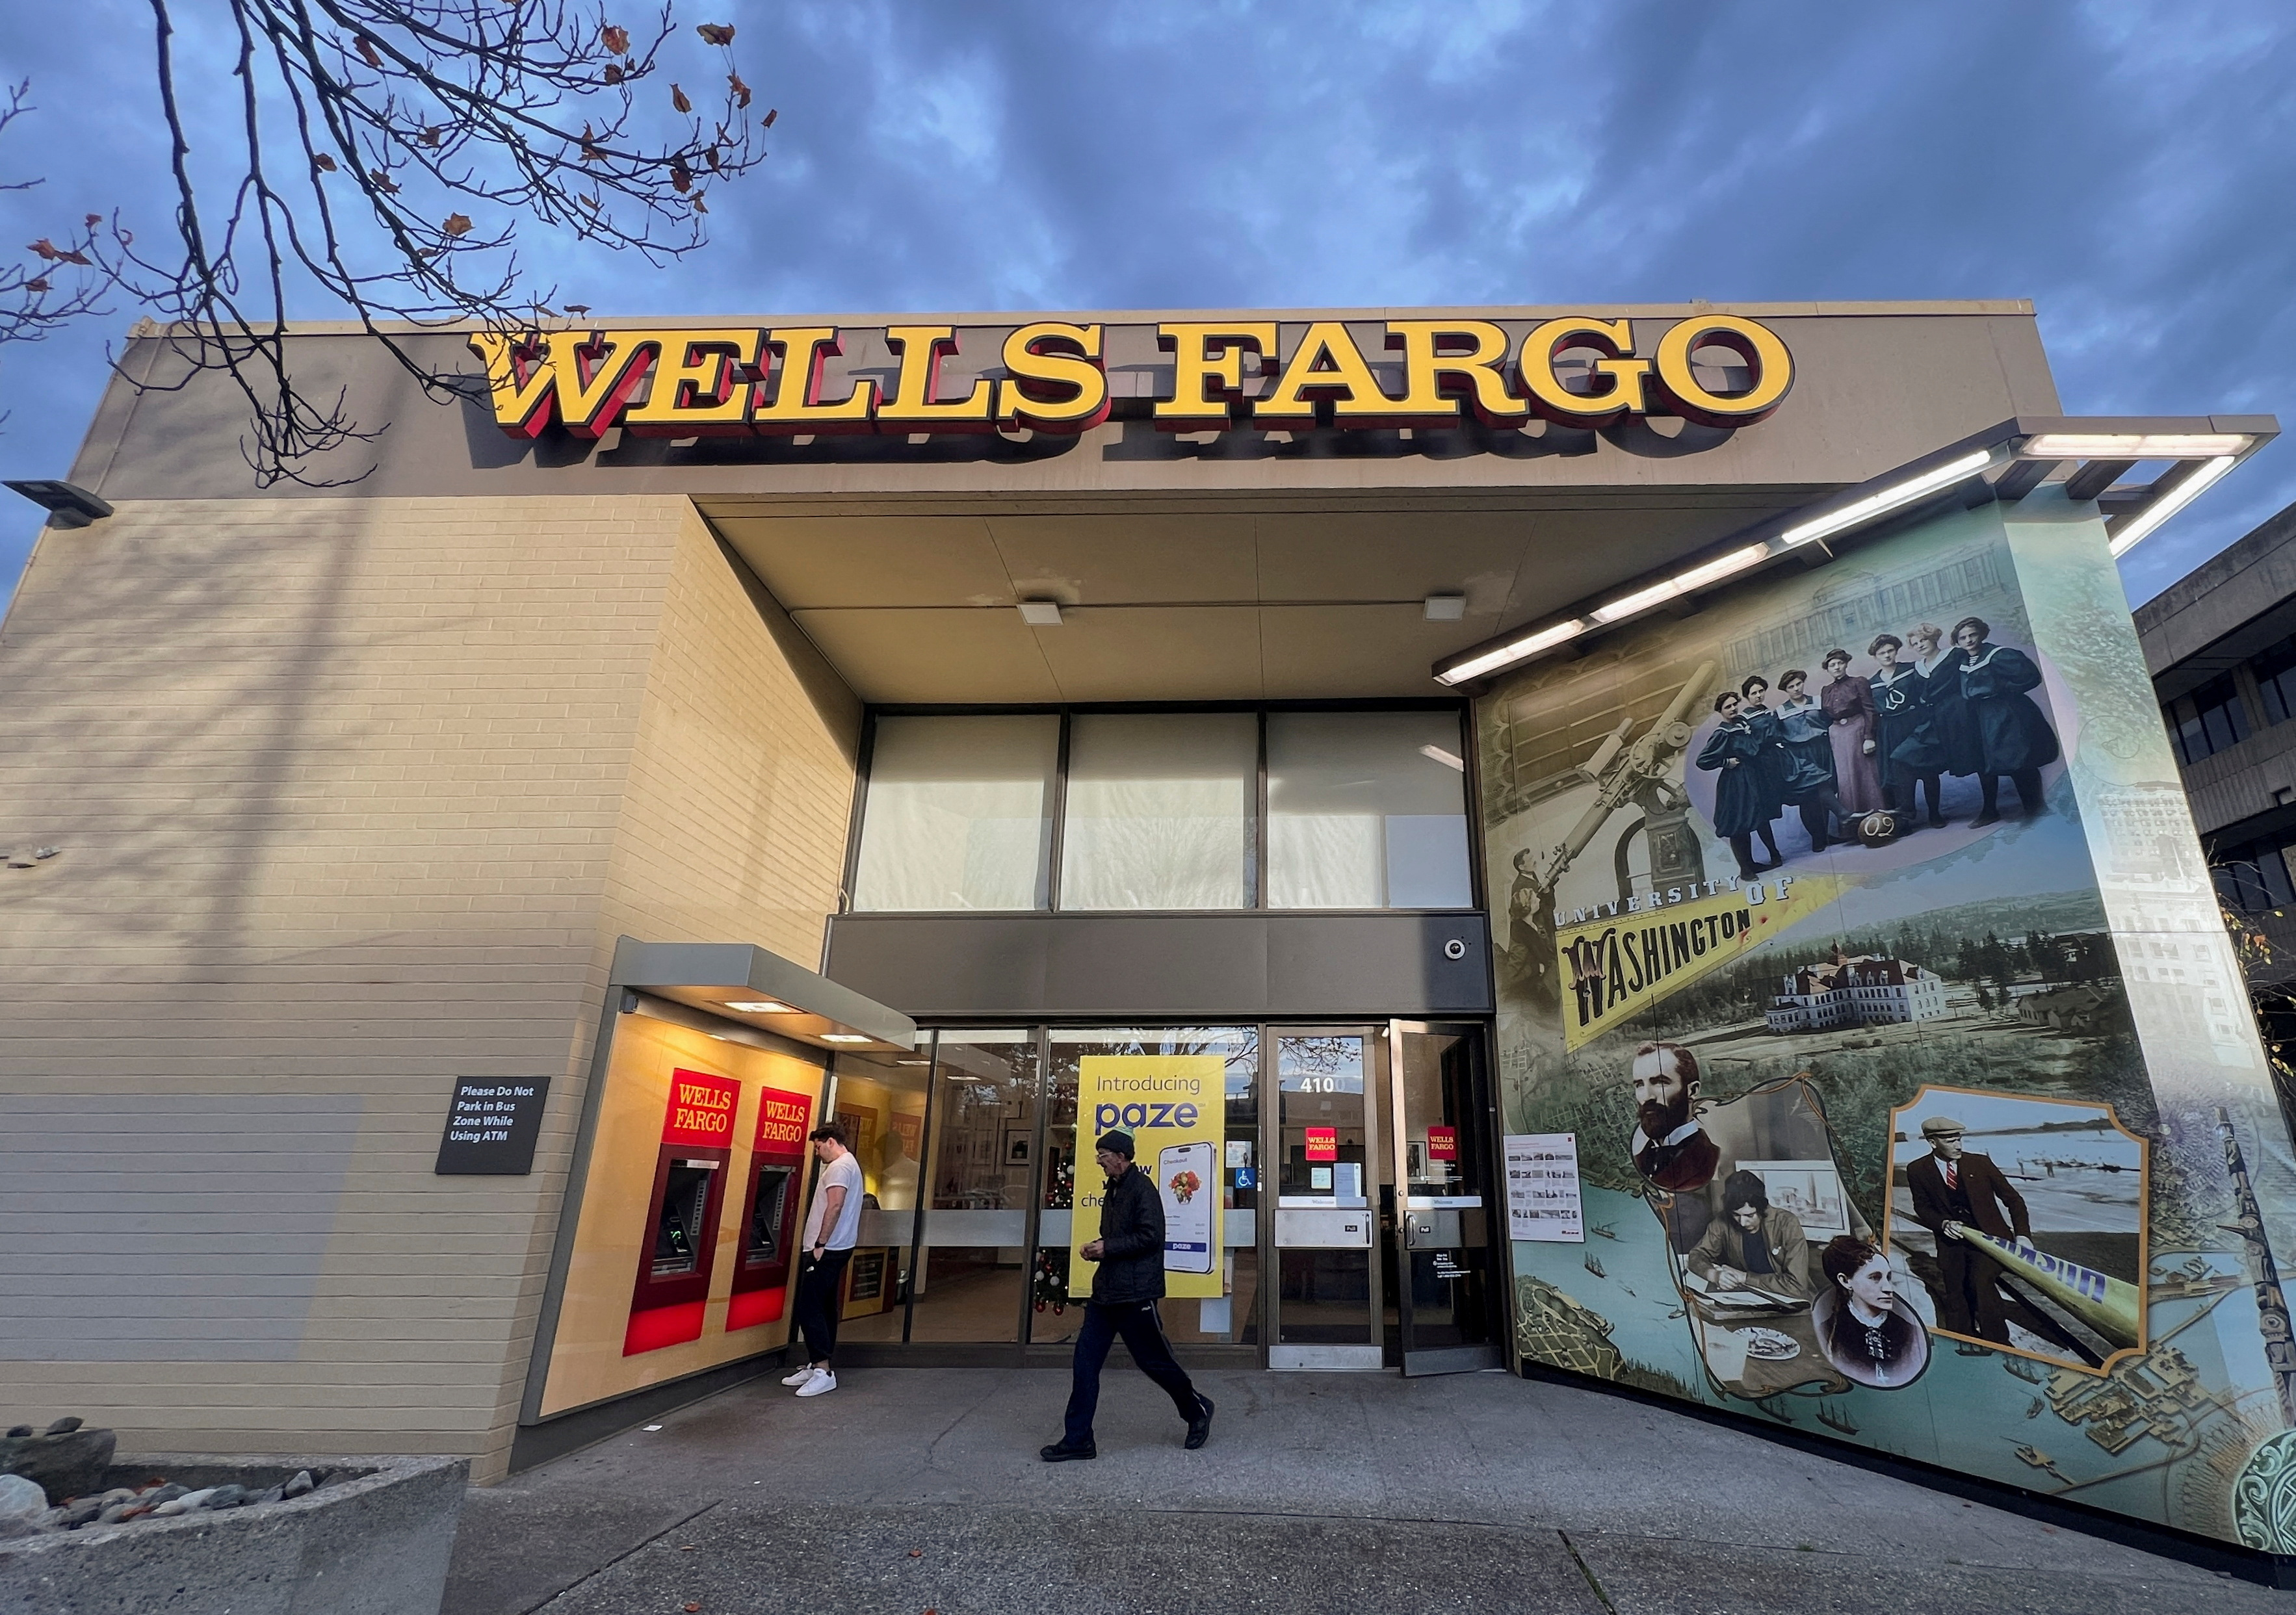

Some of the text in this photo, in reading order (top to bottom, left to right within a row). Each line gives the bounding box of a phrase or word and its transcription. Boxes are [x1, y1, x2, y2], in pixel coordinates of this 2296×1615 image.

[468, 315, 1793, 432] WELLS FARGO
[1553, 875, 1794, 927] UNIVERSITY OF
[1561, 909, 1751, 1027] WASHINGTON
[460, 1086, 534, 1096] Please Do Not
[1097, 1075, 1200, 1095] Introducing
[1300, 1077, 1334, 1093] 410
[457, 1101, 515, 1111] Park in Bus
[679, 1083, 731, 1110] WELLS
[452, 1116, 514, 1126] Zone While
[673, 1108, 727, 1133] FARGO
[766, 1100, 805, 1123] WELLS
[1095, 1103, 1198, 1136] paze
[450, 1131, 508, 1143] Using ATM
[763, 1121, 802, 1143] FARGO
